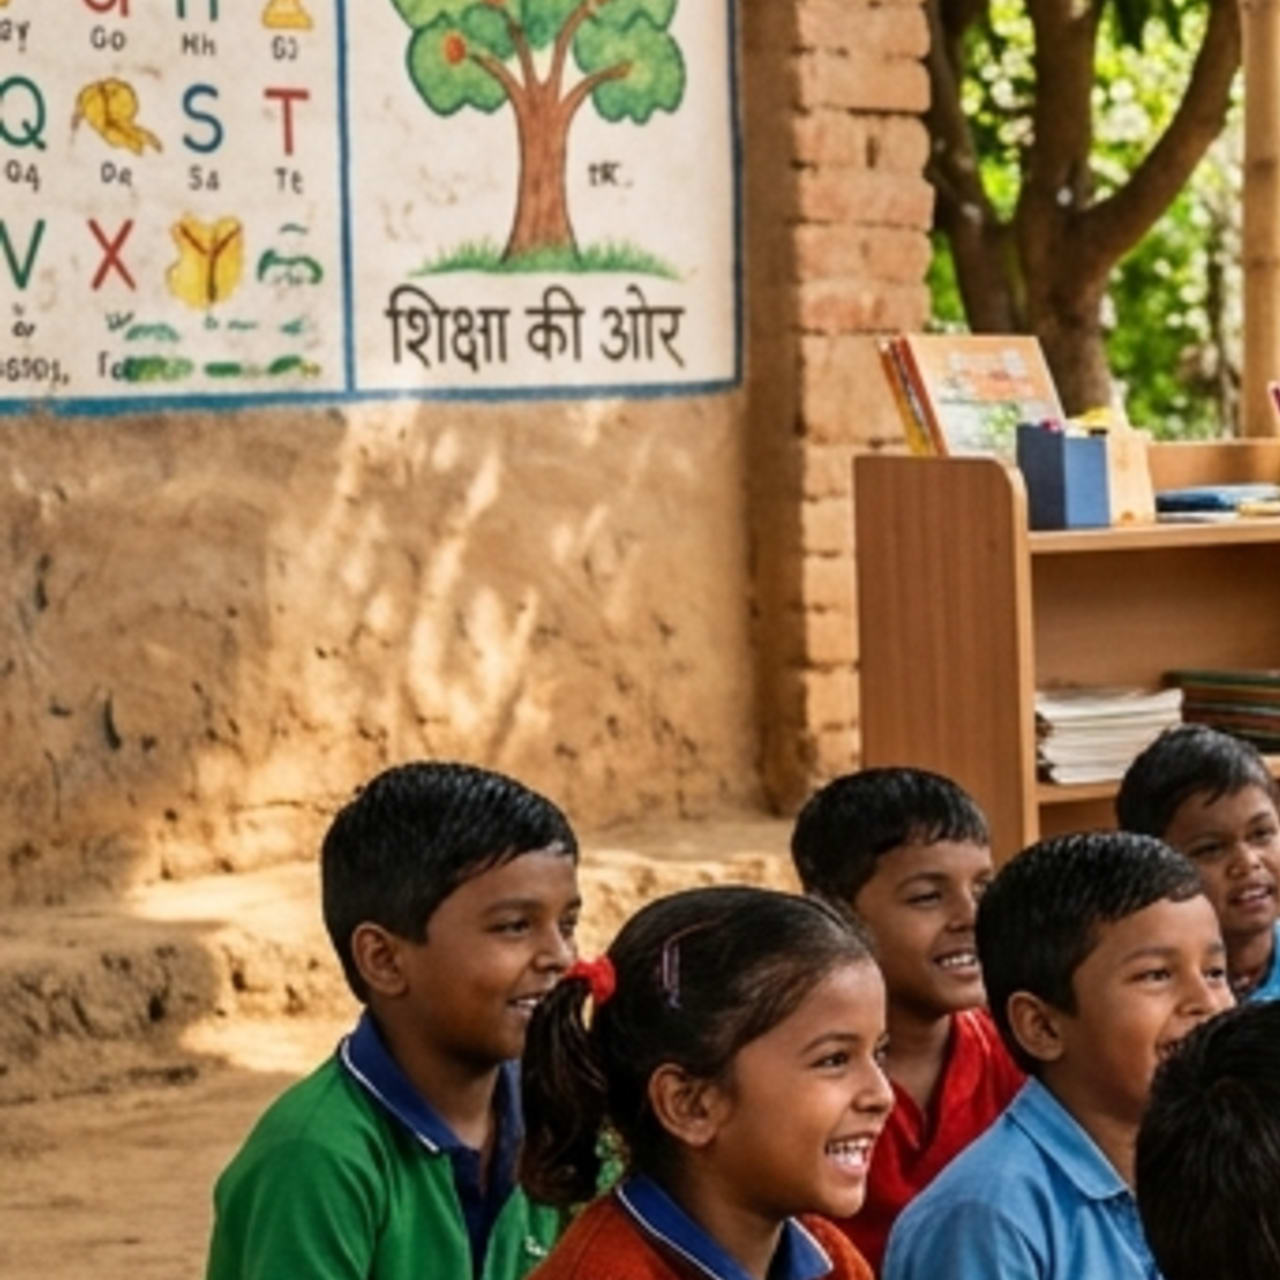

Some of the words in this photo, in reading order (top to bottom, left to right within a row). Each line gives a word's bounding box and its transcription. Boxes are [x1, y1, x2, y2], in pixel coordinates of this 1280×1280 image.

[0, 76, 46, 151] Q
[183, 84, 223, 153] S
[264, 88, 309, 155] T
[0, 220, 45, 290] V
[88, 219, 135, 290] X
[385, 284, 510, 372] शिक्षा
[525, 286, 585, 359] की
[602, 284, 685, 366] ओर
